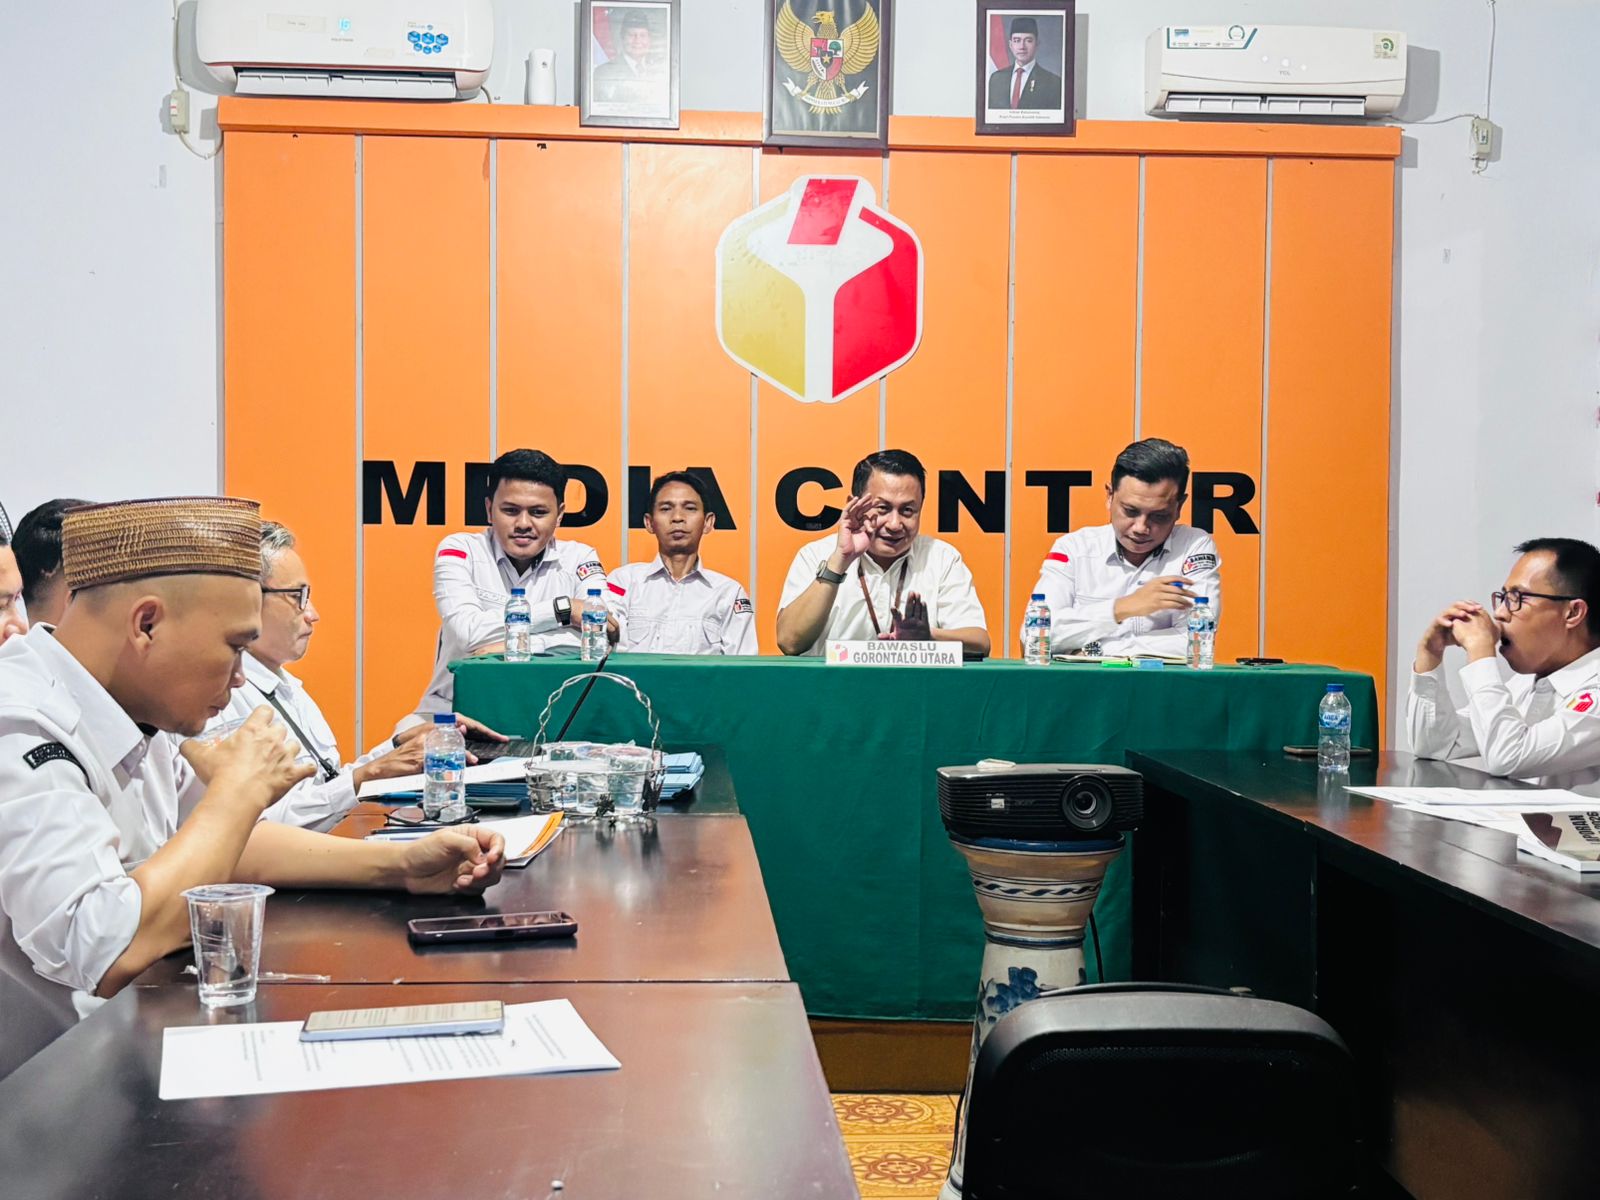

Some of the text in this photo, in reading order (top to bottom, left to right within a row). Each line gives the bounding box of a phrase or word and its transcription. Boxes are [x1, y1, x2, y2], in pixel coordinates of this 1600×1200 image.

[775, 466, 1260, 534] CNTR
[867, 641, 937, 651] BAWASLU
[853, 652, 956, 665] GORONTALO UTARA
